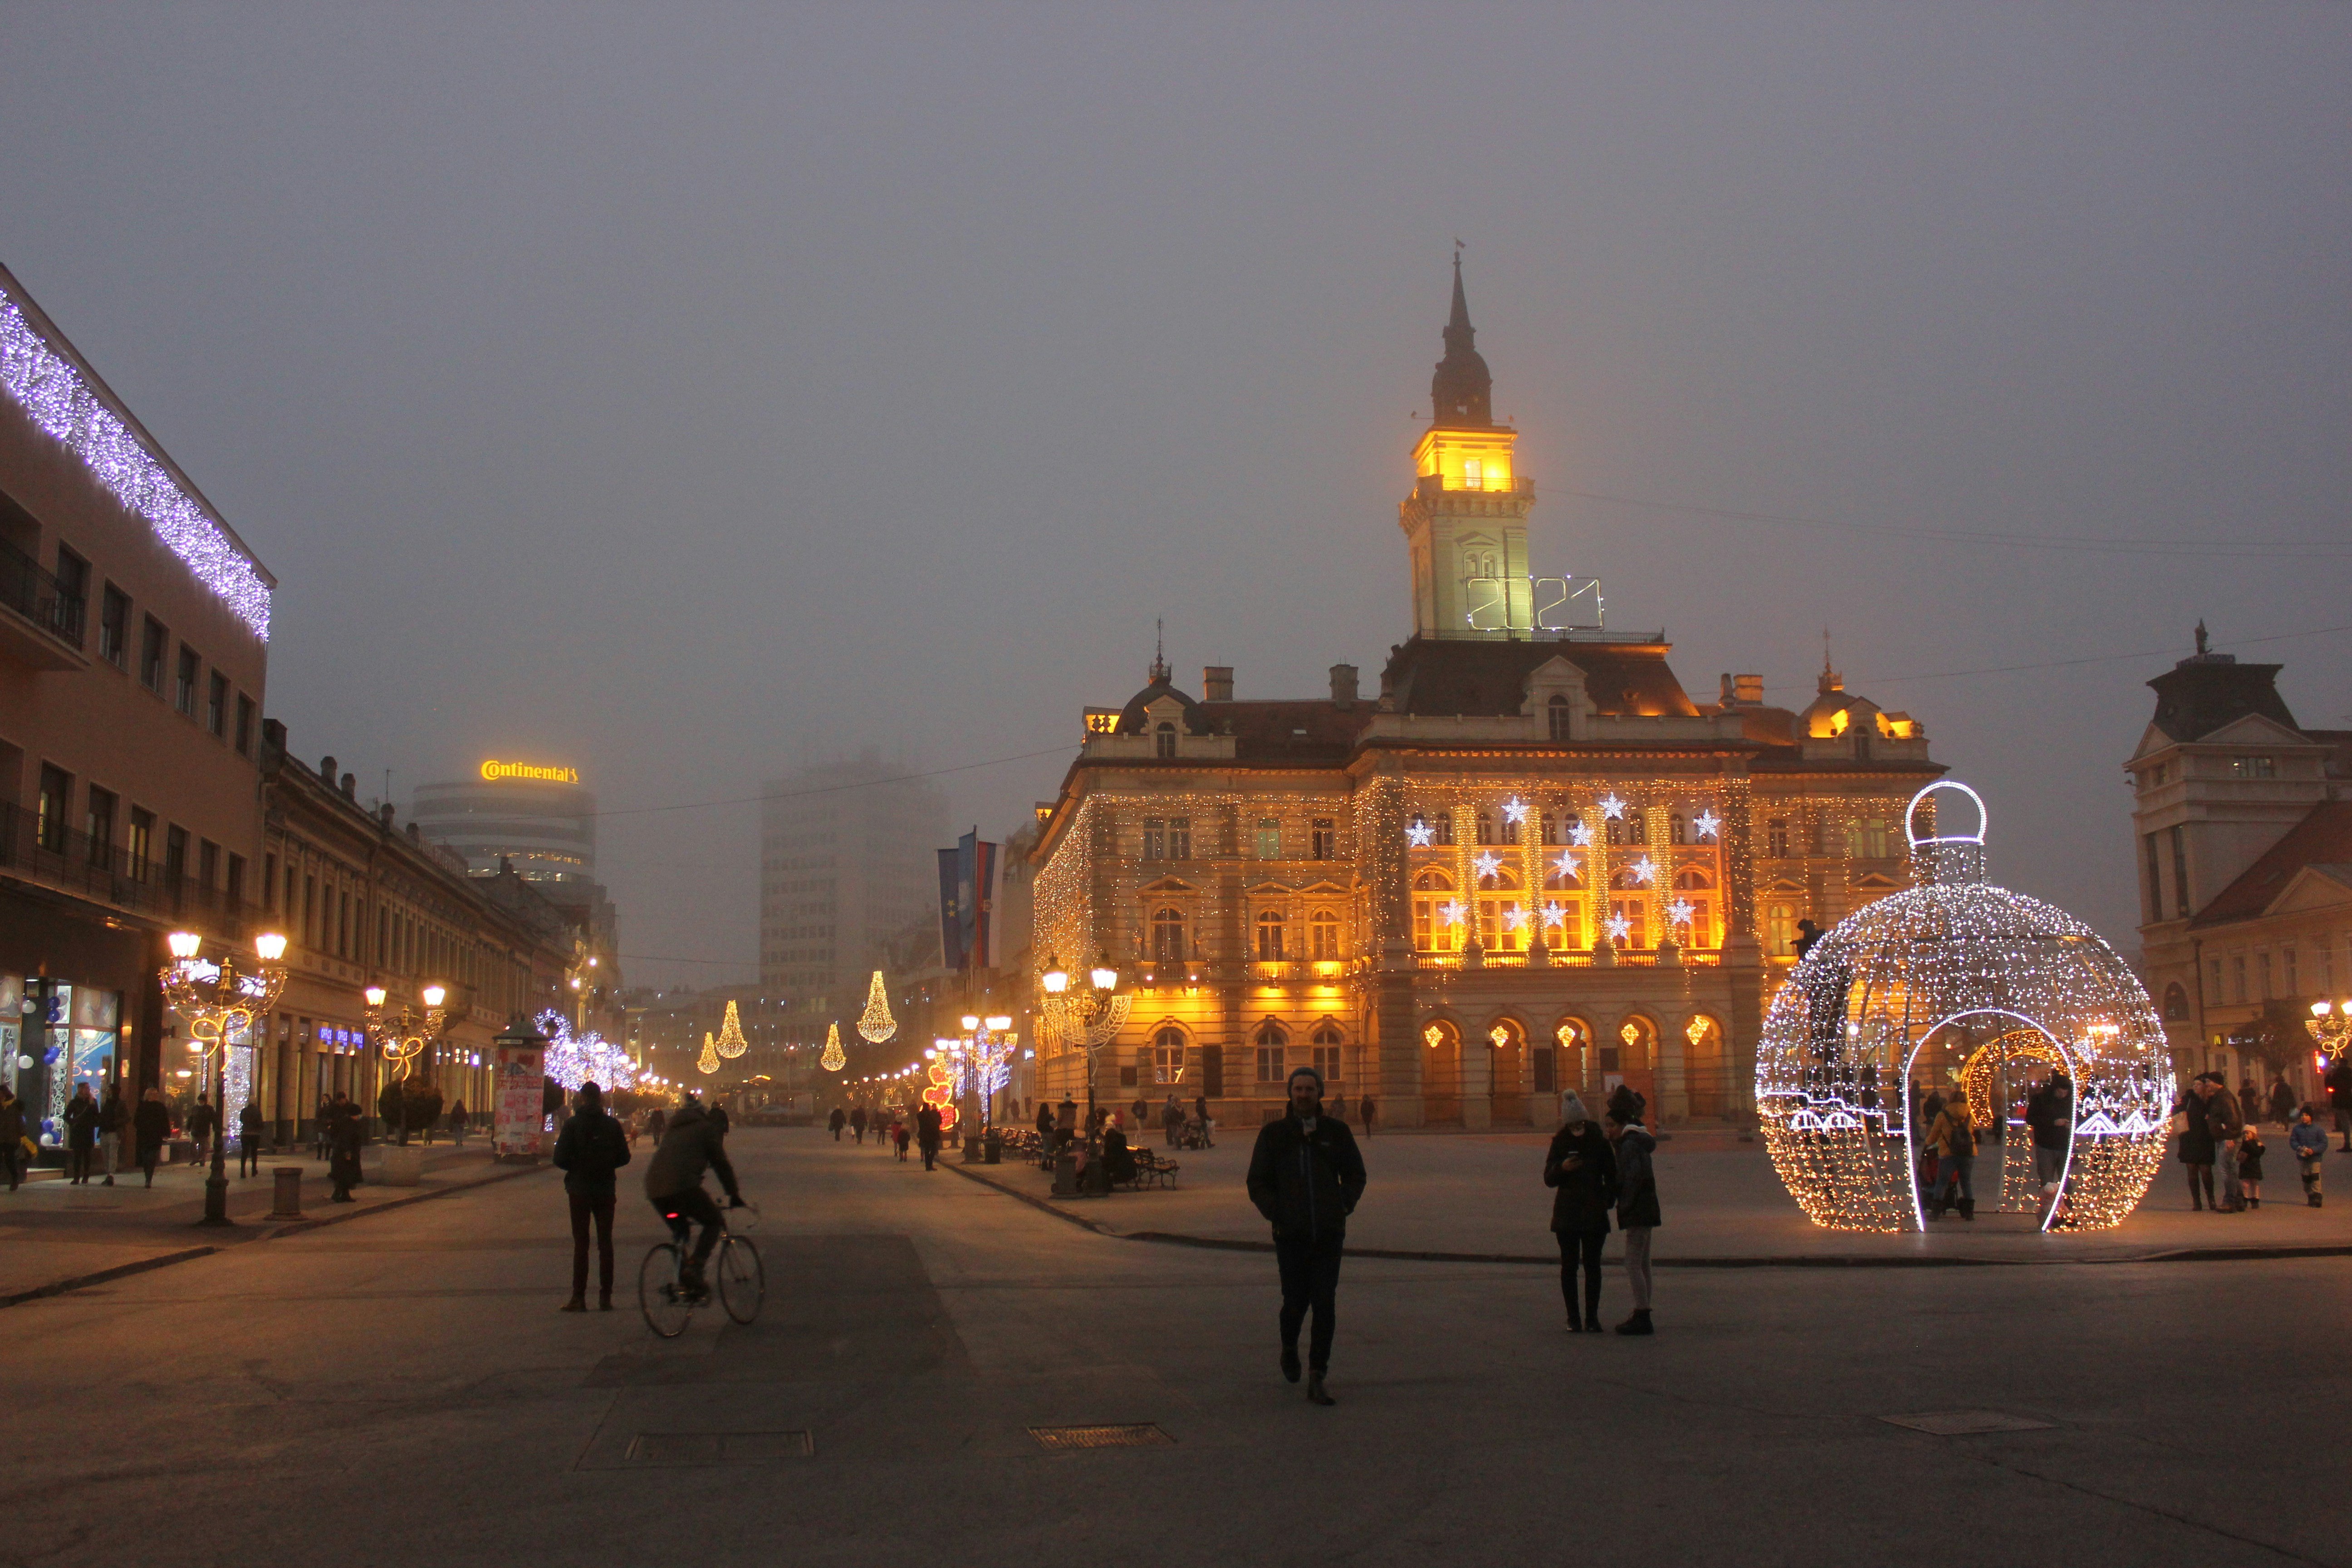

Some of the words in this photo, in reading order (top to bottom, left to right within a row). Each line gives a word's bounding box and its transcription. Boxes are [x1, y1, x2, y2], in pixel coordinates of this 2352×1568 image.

[1469, 578, 1602, 630] 2021
[480, 760, 568, 782] Continental
[321, 1028, 332, 1040] OFFICE
[338, 1030, 348, 1041] OFFICE
[353, 1033, 363, 1044] OFFICE
